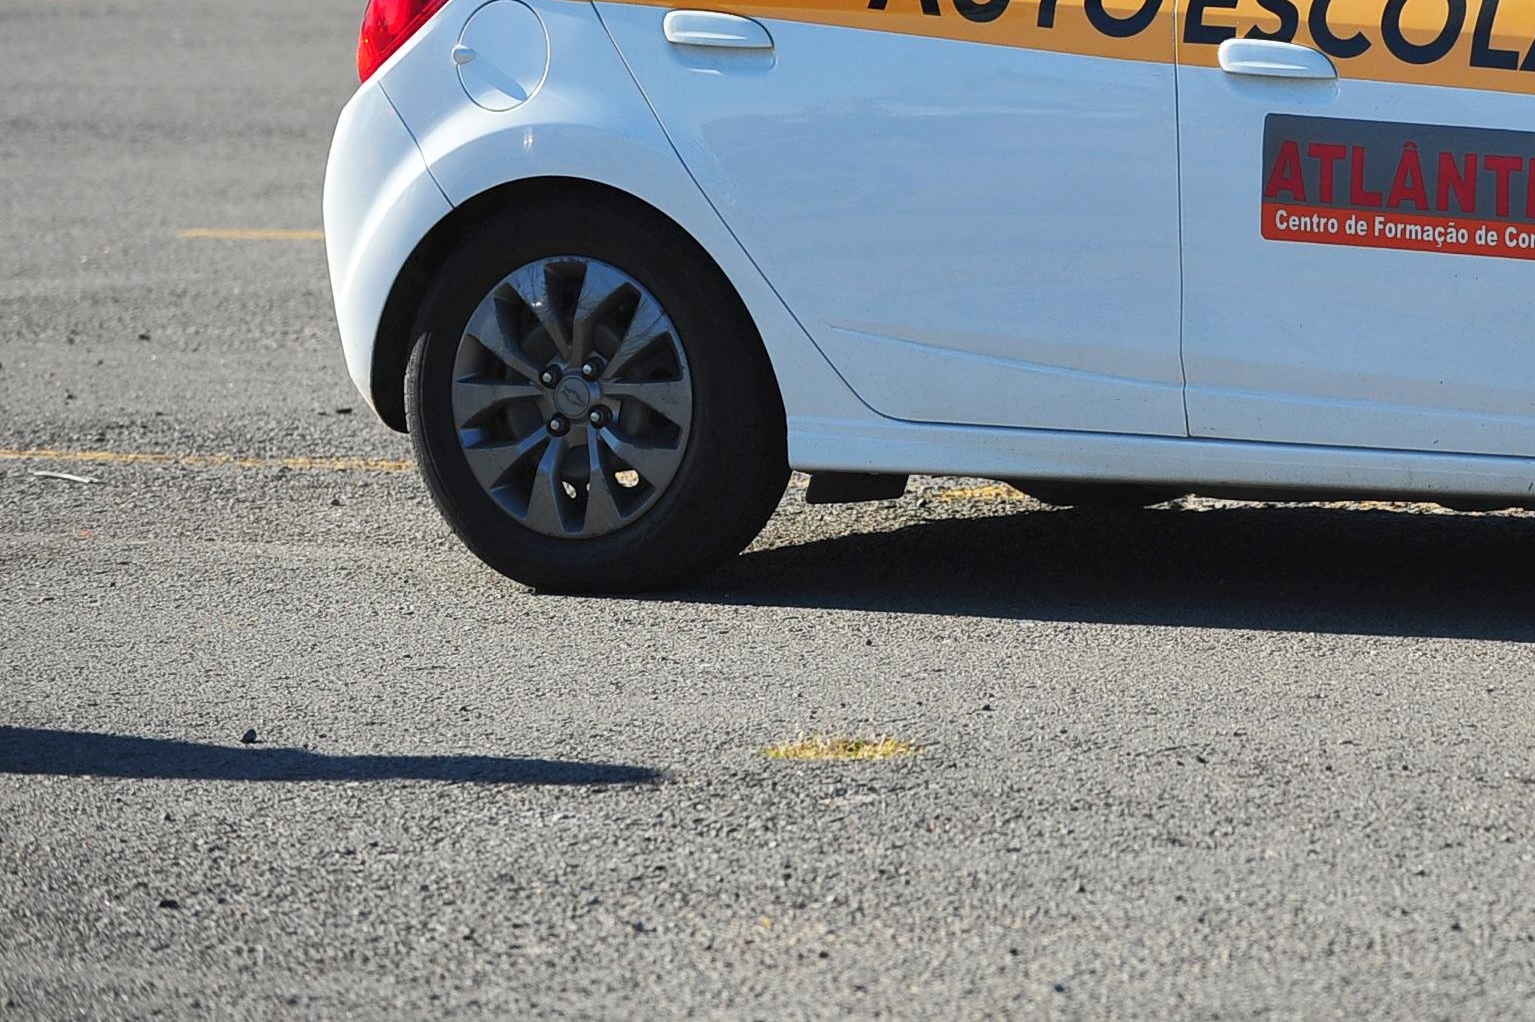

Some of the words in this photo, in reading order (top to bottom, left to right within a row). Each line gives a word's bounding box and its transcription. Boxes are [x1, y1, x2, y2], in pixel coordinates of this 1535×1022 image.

[1275, 209, 1339, 234] Centro
[1345, 214, 1368, 236] de
[1374, 216, 1469, 248] Formação
[1475, 225, 1498, 247] de
